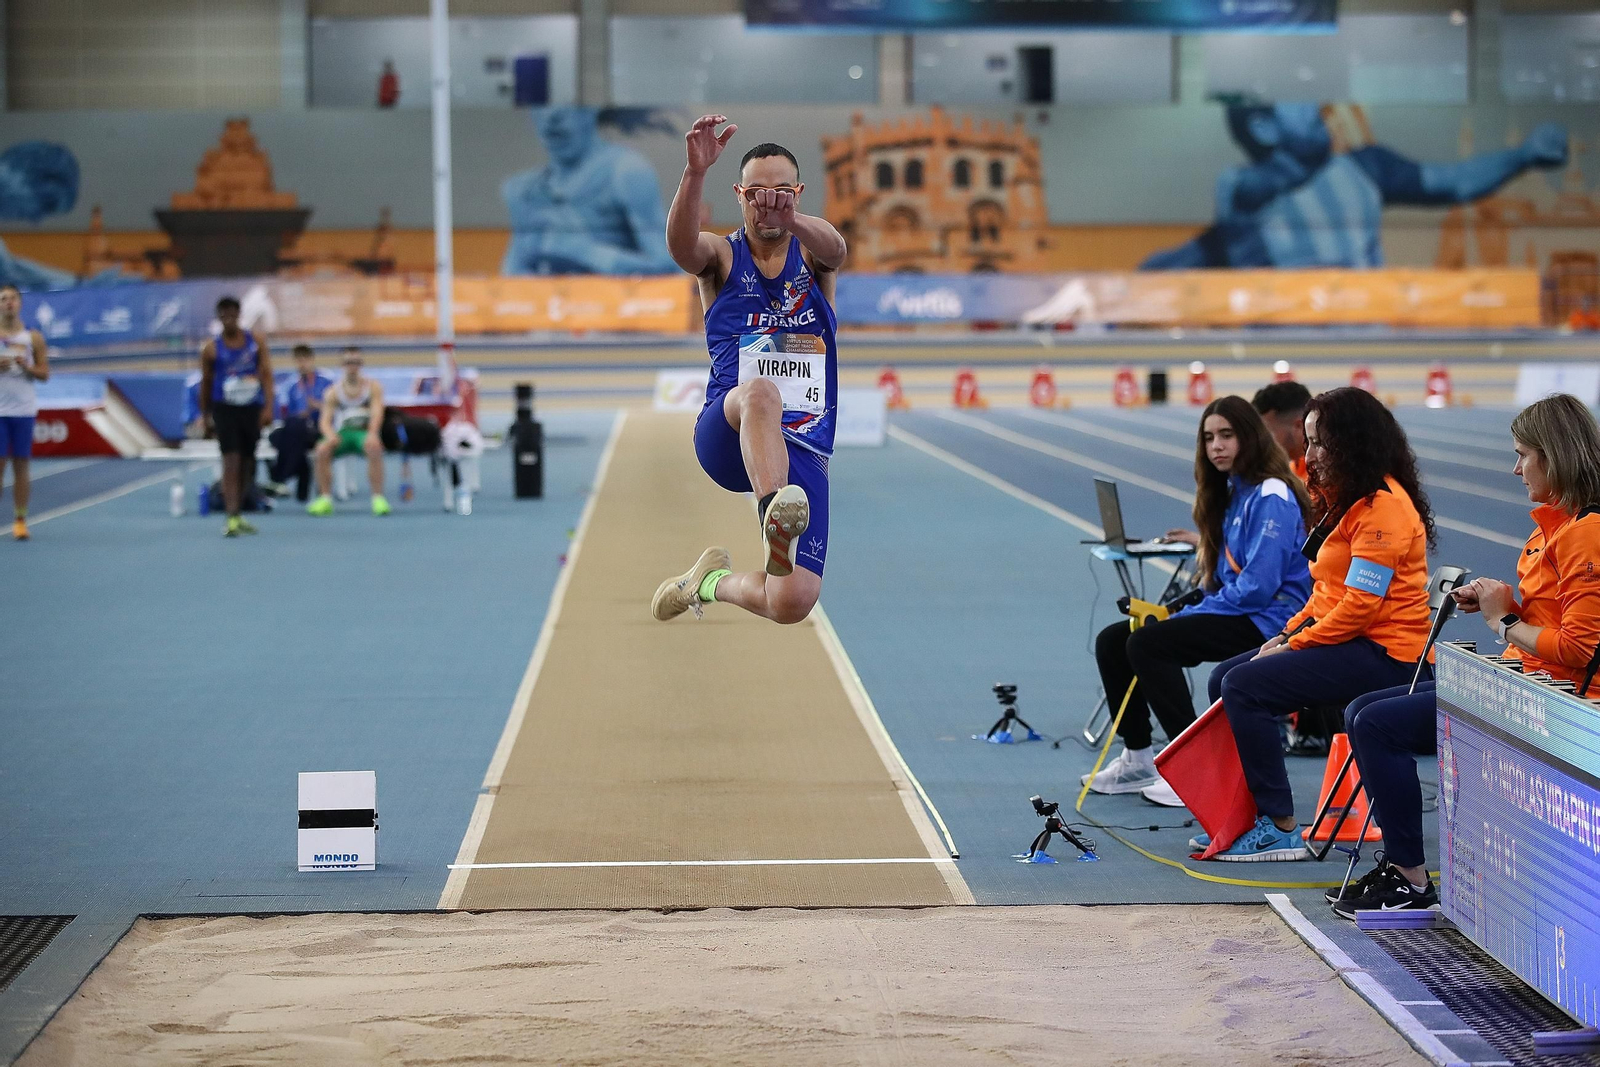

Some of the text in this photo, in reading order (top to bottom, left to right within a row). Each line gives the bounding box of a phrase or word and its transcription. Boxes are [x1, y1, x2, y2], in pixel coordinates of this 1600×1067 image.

[758, 308, 816, 327] FRANCE
[757, 359, 811, 379] VIRAPIN
[805, 387, 819, 402] 45
[1499, 758, 1544, 820] NICOLAS
[1544, 778, 1591, 848] VIRAPIN
[313, 853, 359, 862] MONDO
